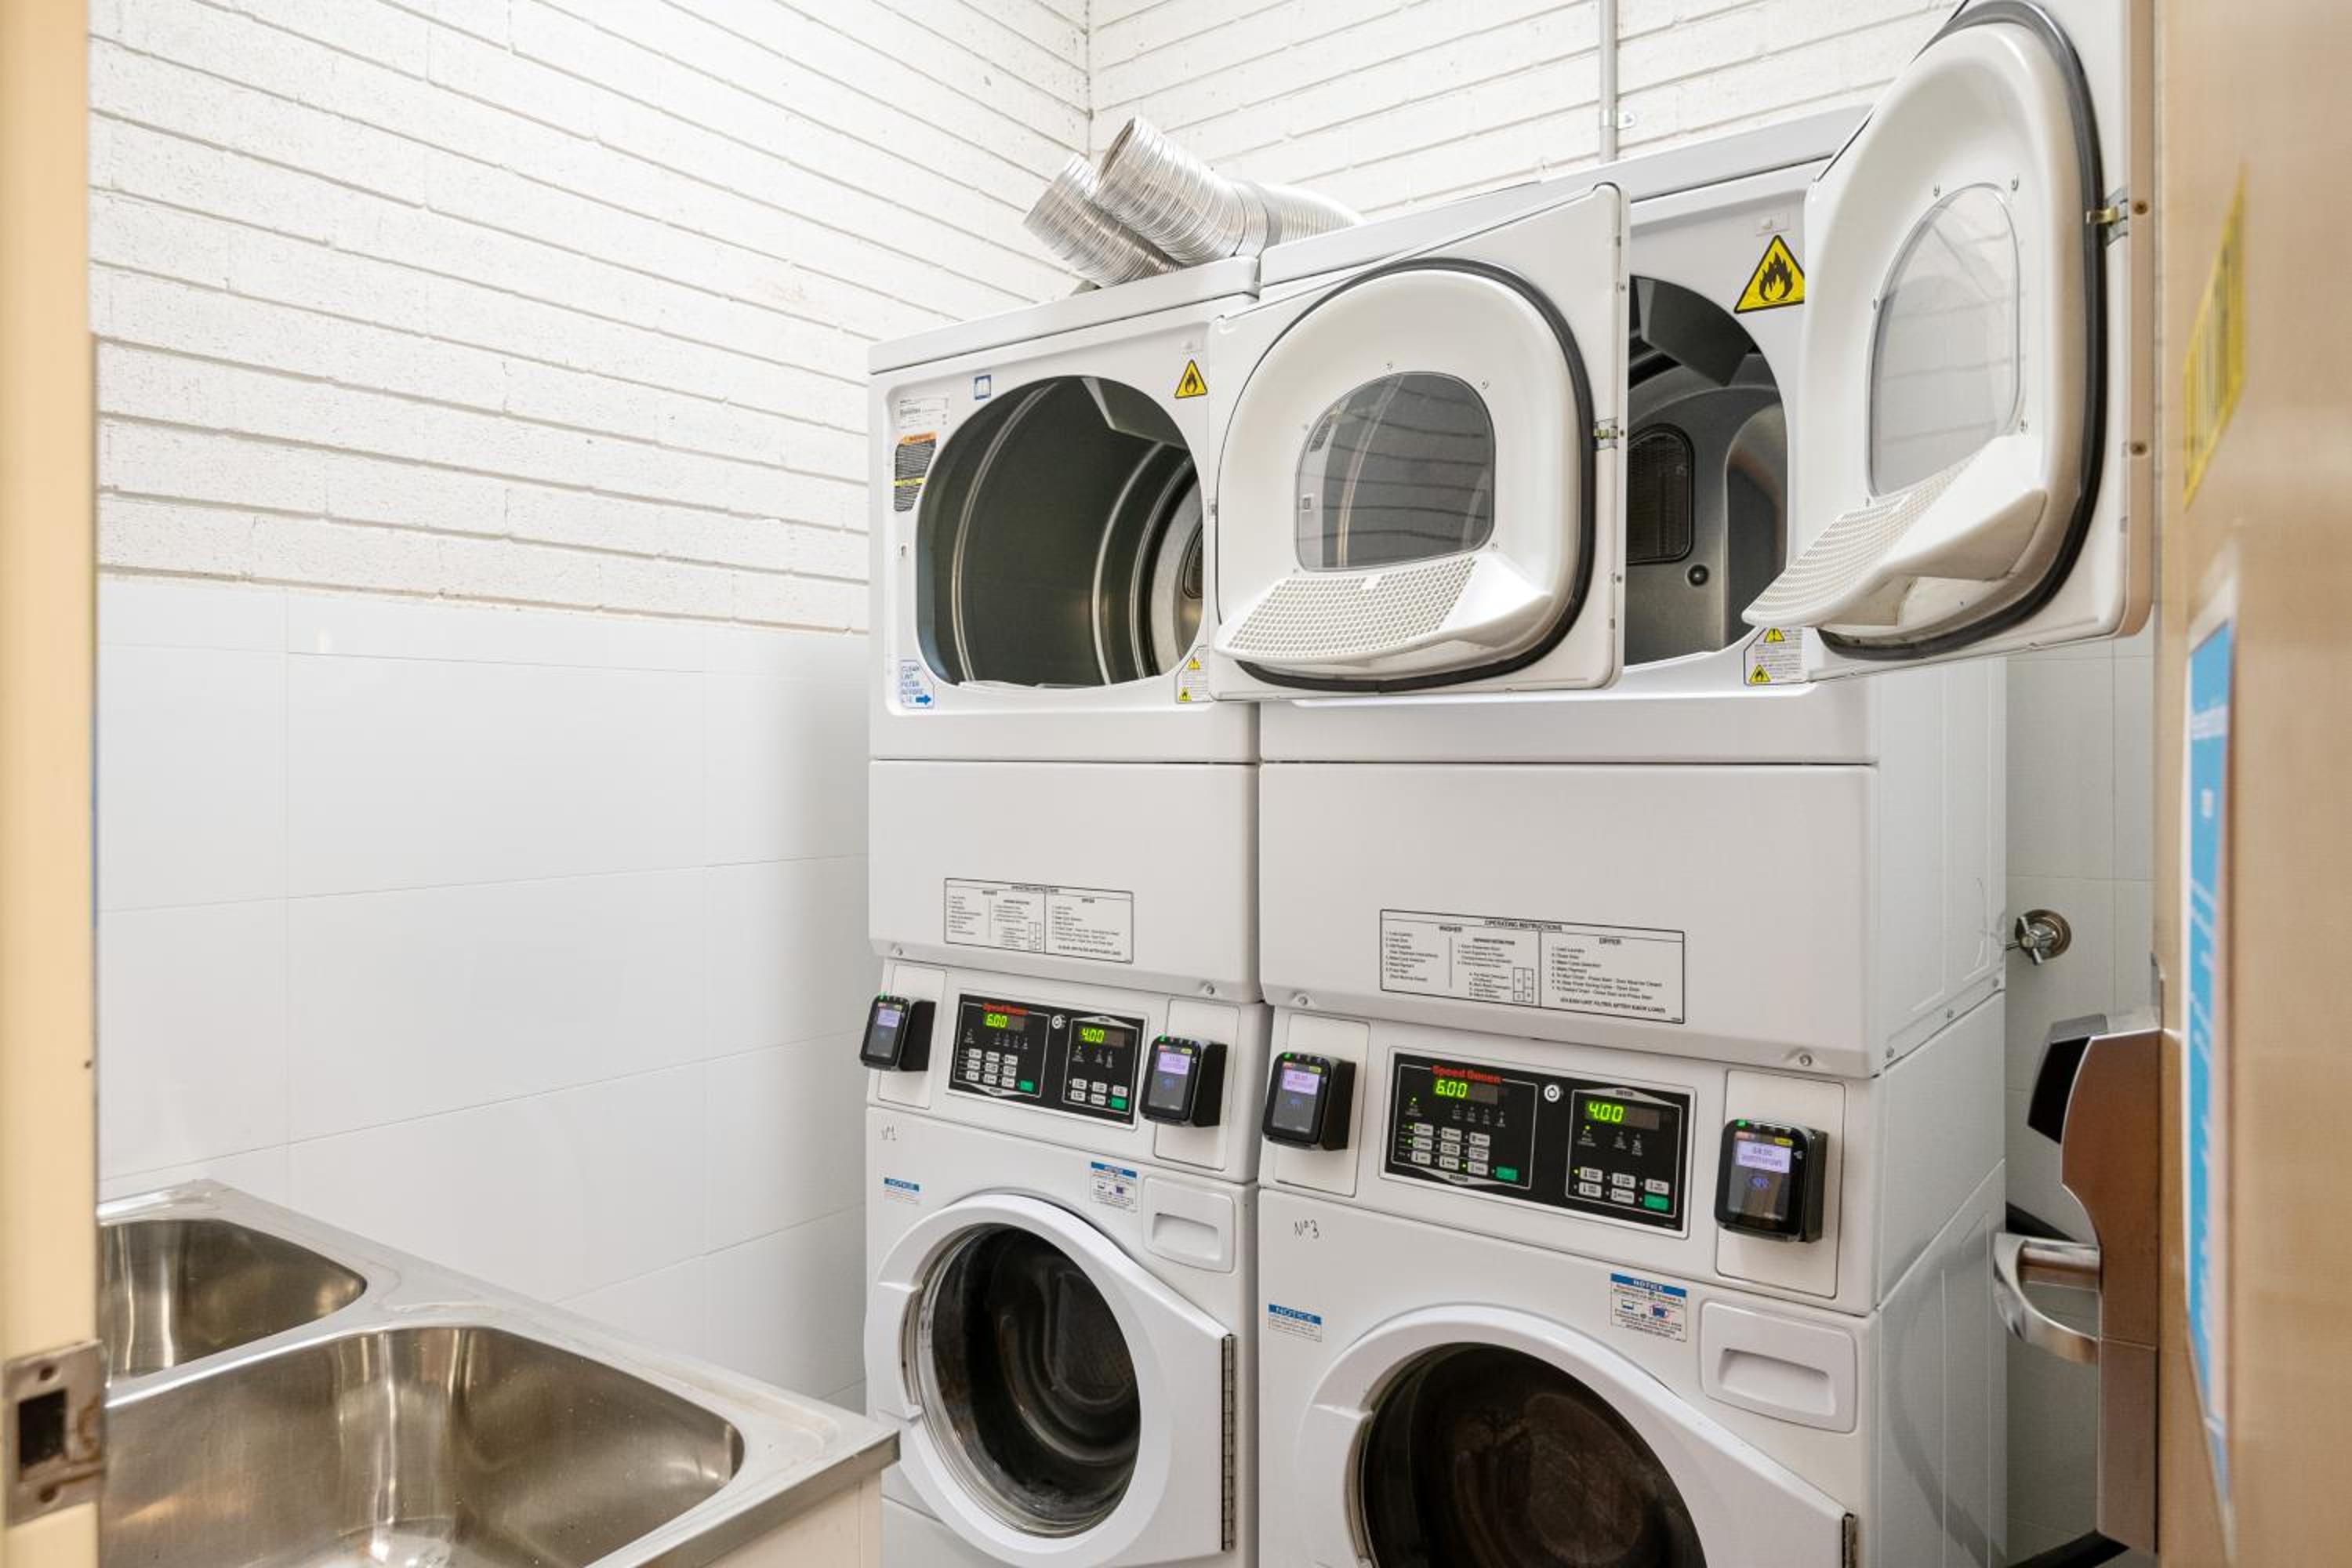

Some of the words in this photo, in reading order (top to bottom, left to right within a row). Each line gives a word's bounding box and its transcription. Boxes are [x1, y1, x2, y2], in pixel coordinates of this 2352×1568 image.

[1483, 919, 1519, 928] OPERATING
[1432, 1065, 1466, 1079] Speed
[1467, 1069, 1502, 1083] Queen
[1435, 1079, 1468, 1099] 6.00
[1588, 1101, 1624, 1123] 4.00
[1633, 1278, 1663, 1292] NOTICE
[1276, 1307, 1312, 1322] NOTICE
